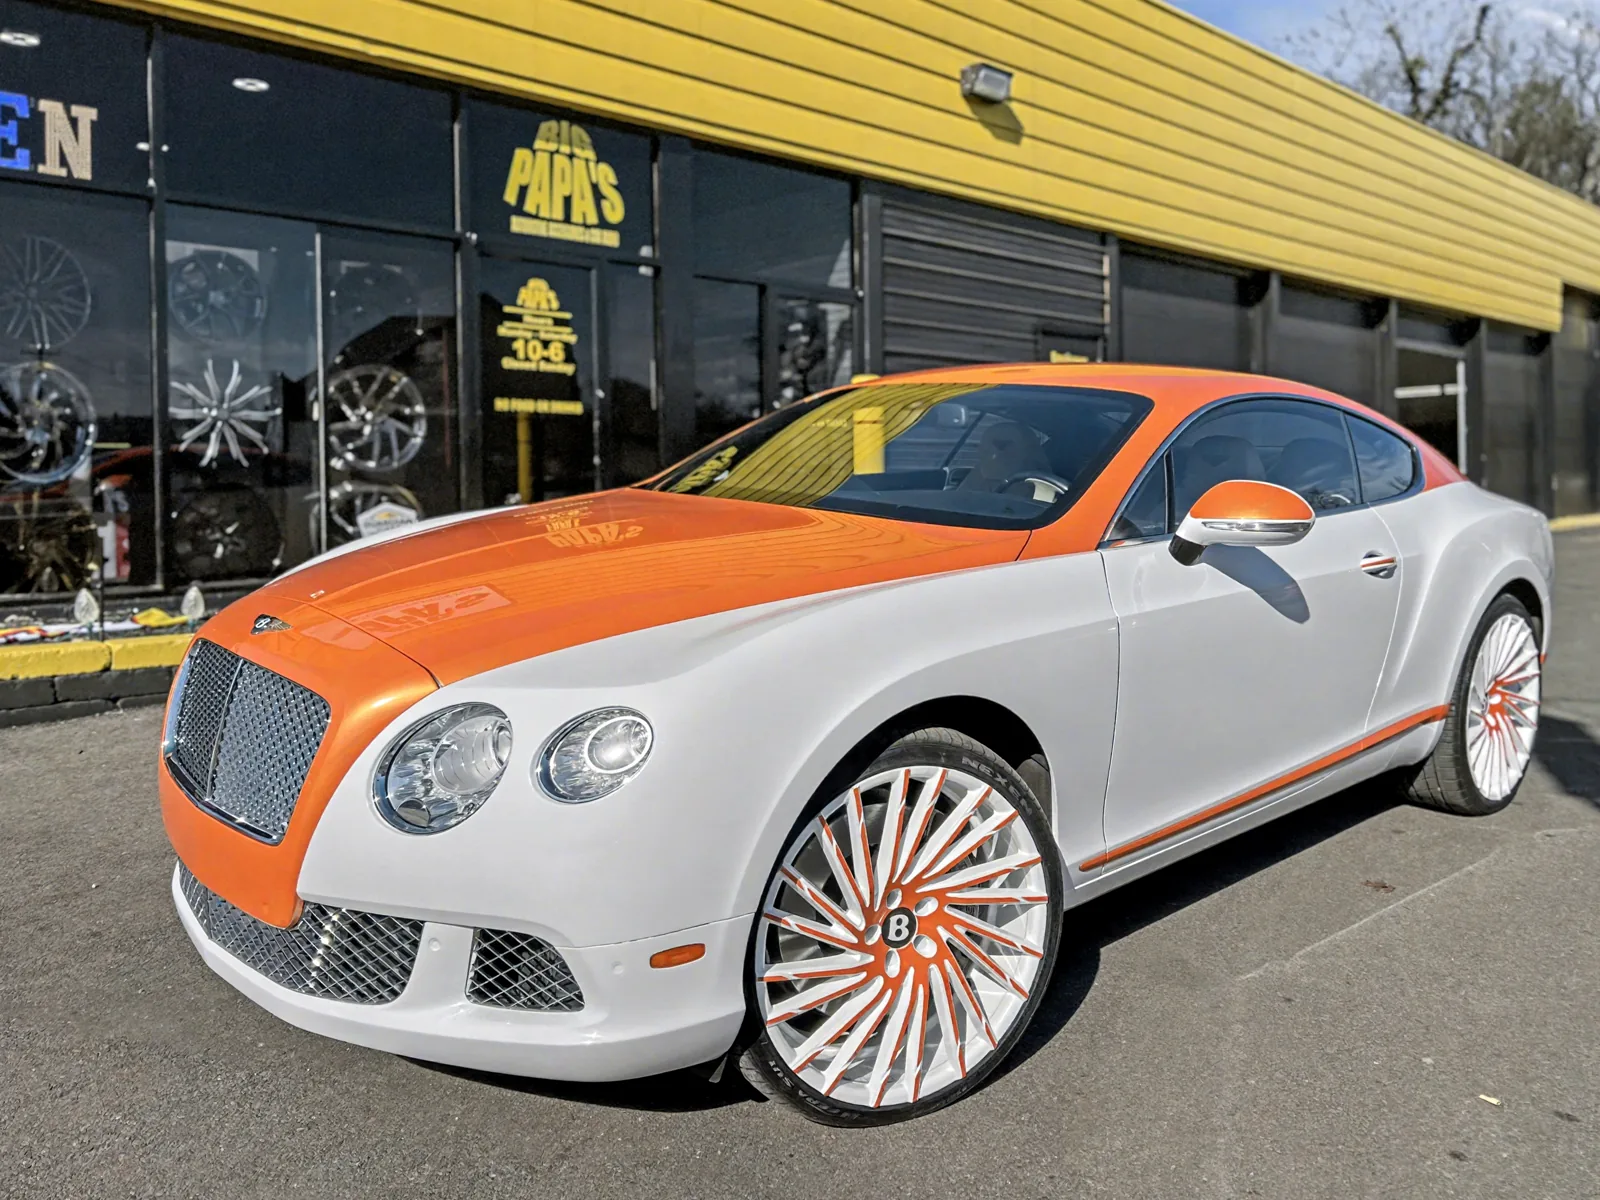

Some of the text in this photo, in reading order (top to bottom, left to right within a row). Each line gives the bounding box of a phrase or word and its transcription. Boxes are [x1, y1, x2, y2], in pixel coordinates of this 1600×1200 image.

[533, 119, 597, 160] BIG
[503, 147, 625, 225] PAPA'S
[512, 338, 565, 362] 10-6
[962, 756, 1033, 816] NEXEN
[888, 914, 910, 942] B
